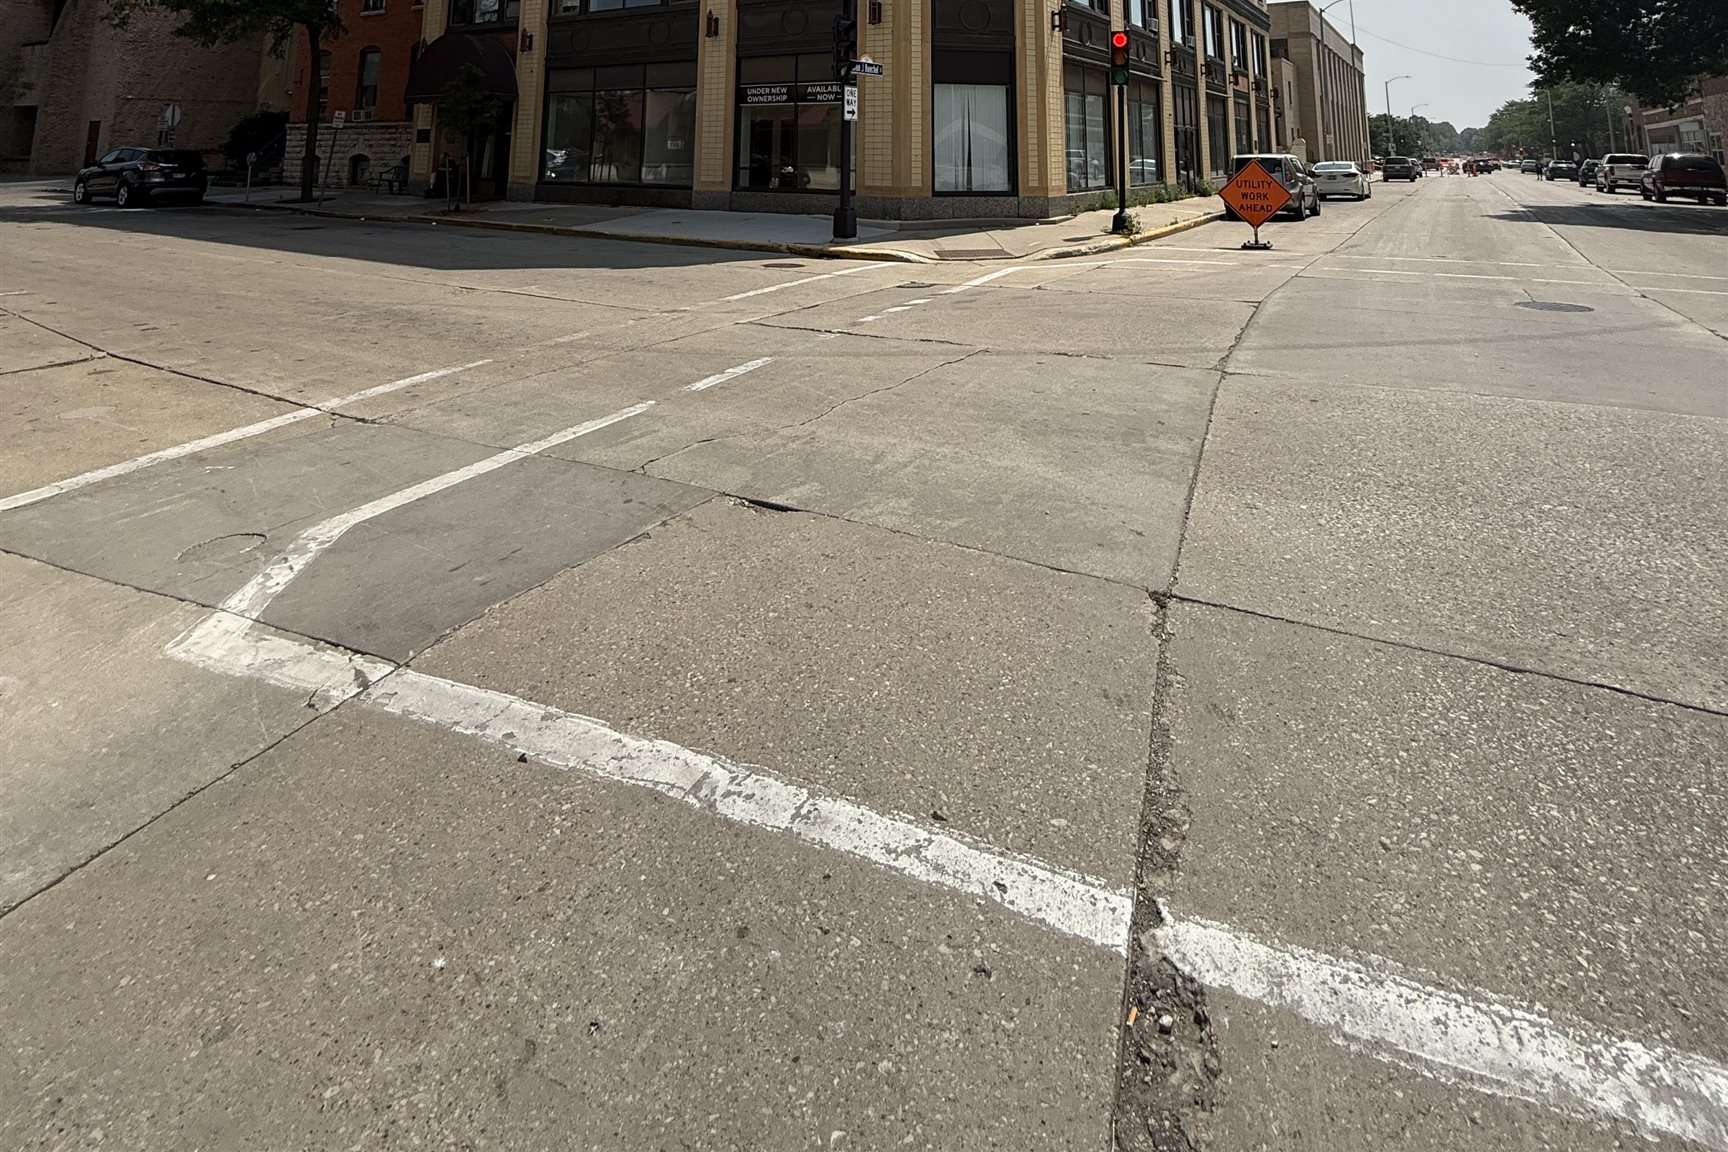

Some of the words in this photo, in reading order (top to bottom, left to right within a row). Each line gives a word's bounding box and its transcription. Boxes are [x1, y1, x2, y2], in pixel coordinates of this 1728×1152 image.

[747, 87, 770, 95] UNDER
[807, 85, 842, 93] AVAILABL
[846, 89, 857, 98] ONE
[747, 94, 788, 103] OWNERSHIP
[817, 93, 836, 101] NOW
[846, 98, 857, 107] WAY
[1236, 180, 1272, 189] UTILITY
[1241, 192, 1269, 201] WORK
[1239, 203, 1273, 212] AHEAD
